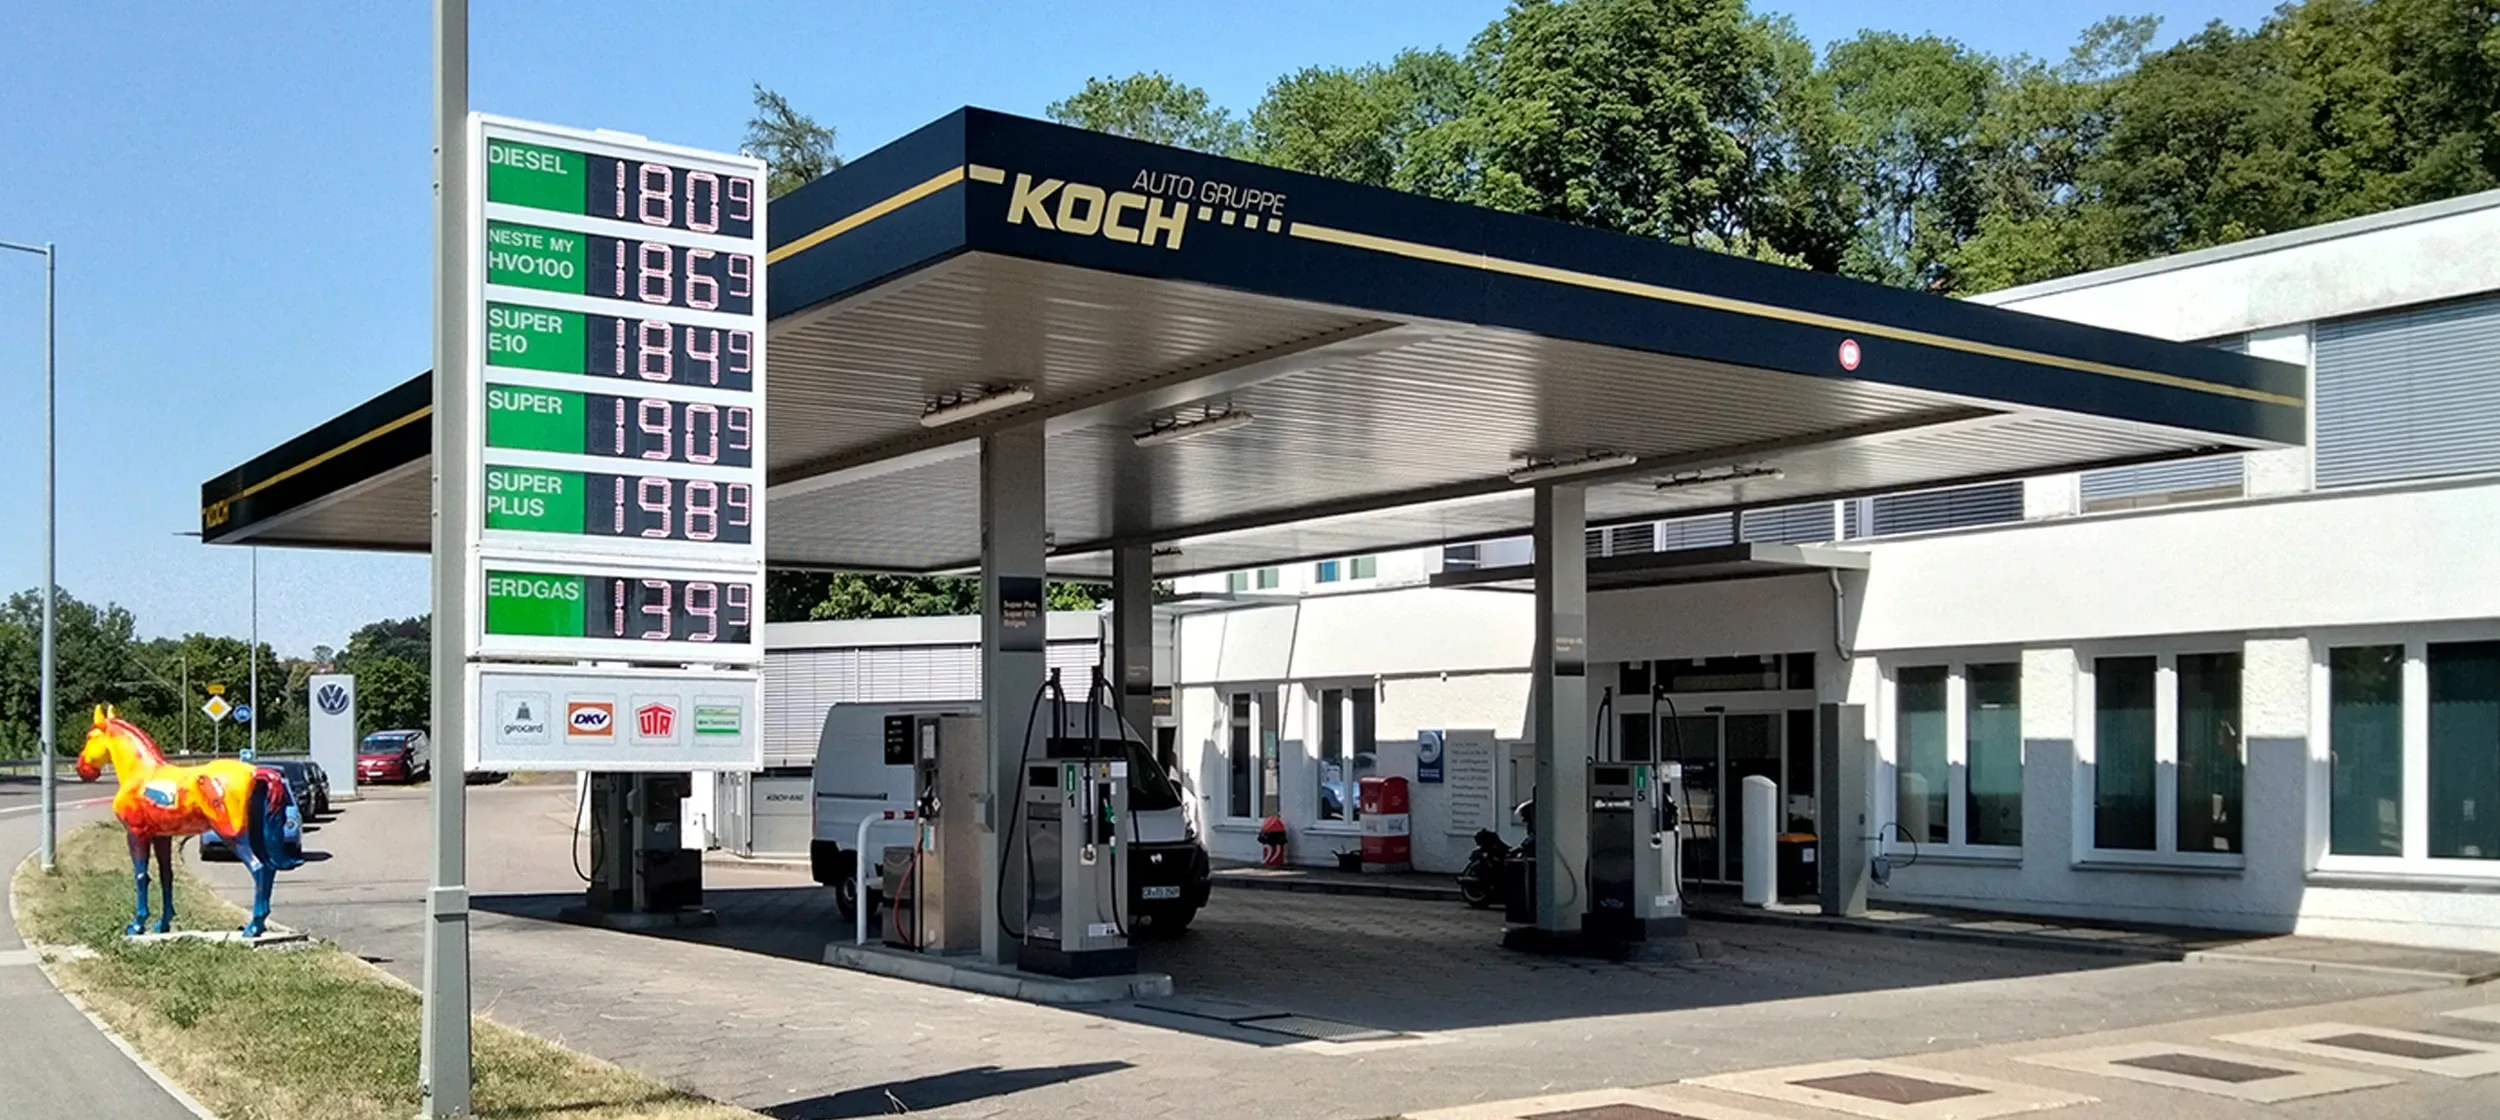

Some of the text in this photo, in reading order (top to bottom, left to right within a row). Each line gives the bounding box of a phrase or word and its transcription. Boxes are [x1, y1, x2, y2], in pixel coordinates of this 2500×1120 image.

[488, 145, 568, 175] DIESEL
[615, 159, 751, 234] 1809
[1006, 172, 1190, 251] KOCH
[488, 229, 574, 254] NESTE MY
[488, 252, 574, 279] HVO100
[615, 239, 751, 311] 1869
[488, 308, 563, 334] SUPER
[488, 333, 527, 354] E10
[615, 317, 751, 386] 1849
[488, 390, 563, 415] SUPER
[614, 398, 751, 465] 1909
[487, 471, 563, 495] SUPER
[487, 496, 545, 517] PLUS
[614, 475, 750, 541] 1989
[487, 578, 579, 601] ERDGAS
[614, 579, 750, 642] 1399
[504, 723, 543, 735] girocard
[574, 713, 608, 725] DKV
[639, 705, 673, 735] UTA
[1637, 790, 1646, 802] 5
